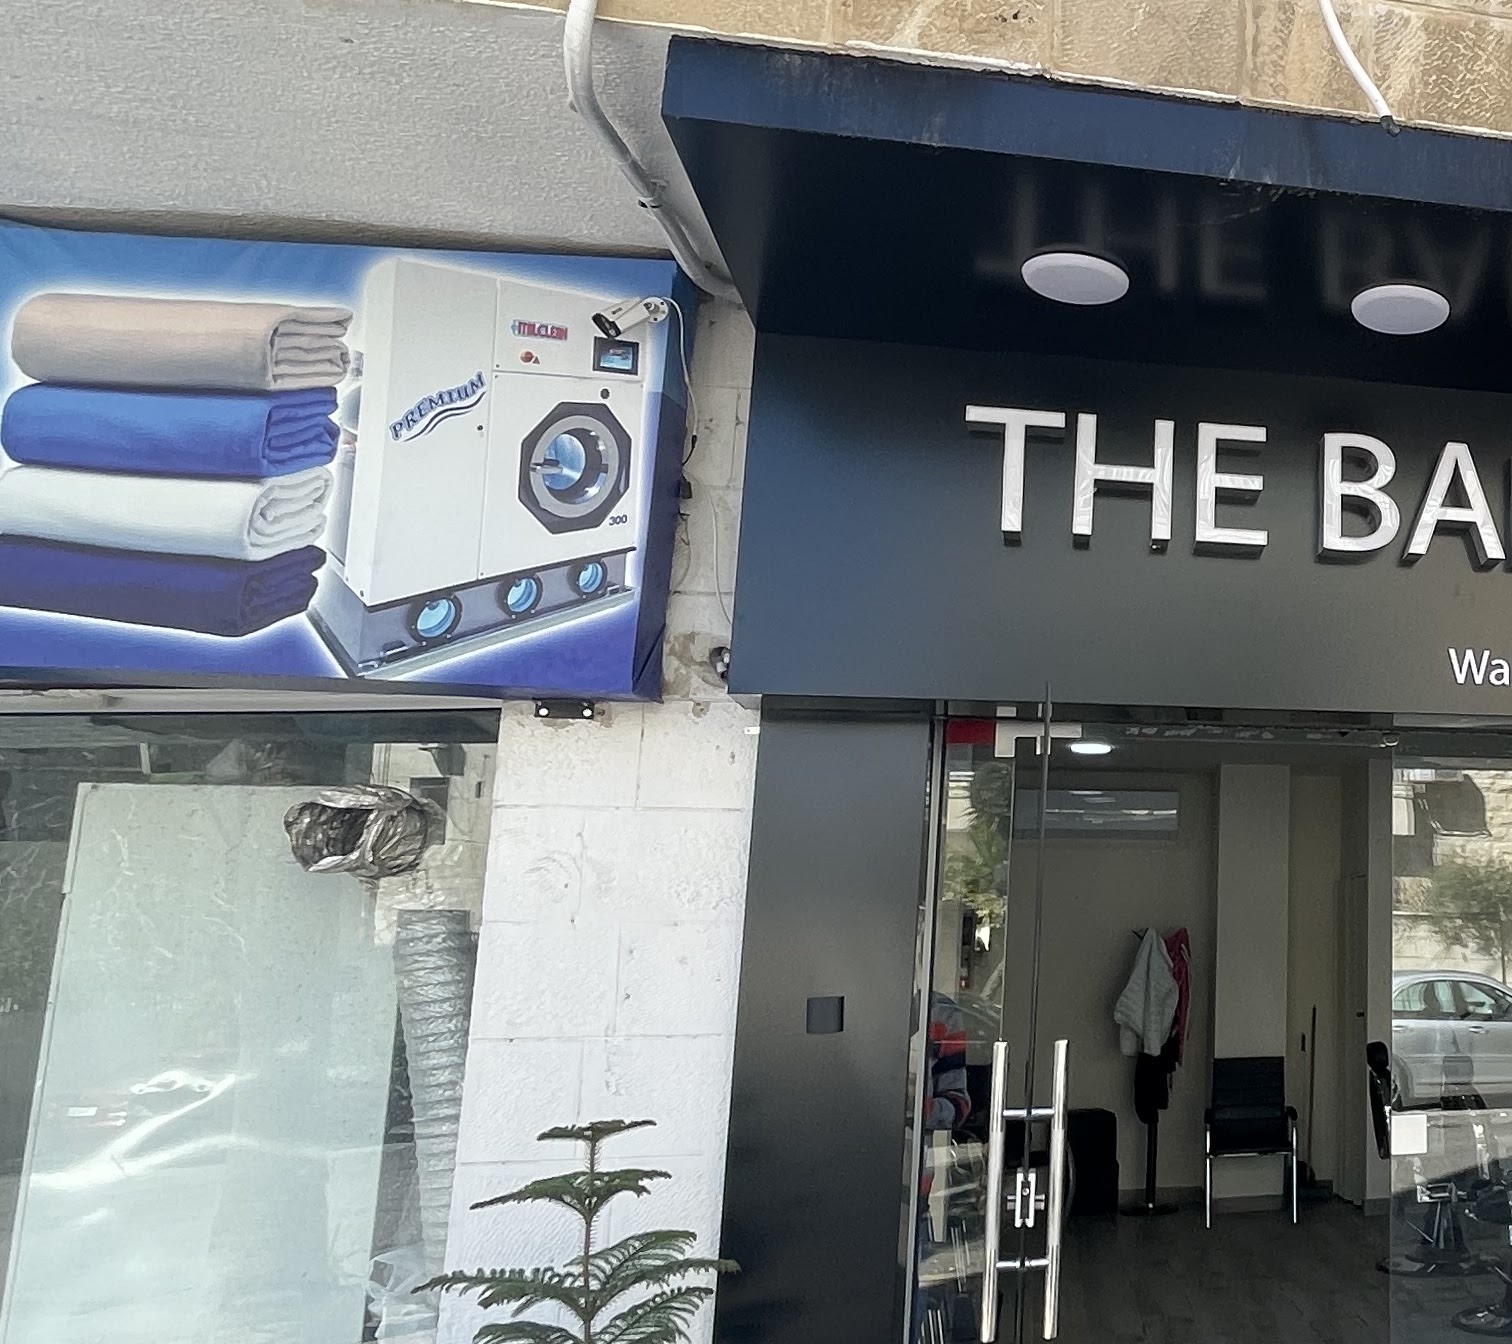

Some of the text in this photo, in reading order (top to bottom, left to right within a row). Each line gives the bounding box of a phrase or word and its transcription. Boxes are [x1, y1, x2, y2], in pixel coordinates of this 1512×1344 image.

[389, 370, 487, 441] PREMIUM
[965, 405, 1269, 550] THE
[609, 514, 628, 526] 300
